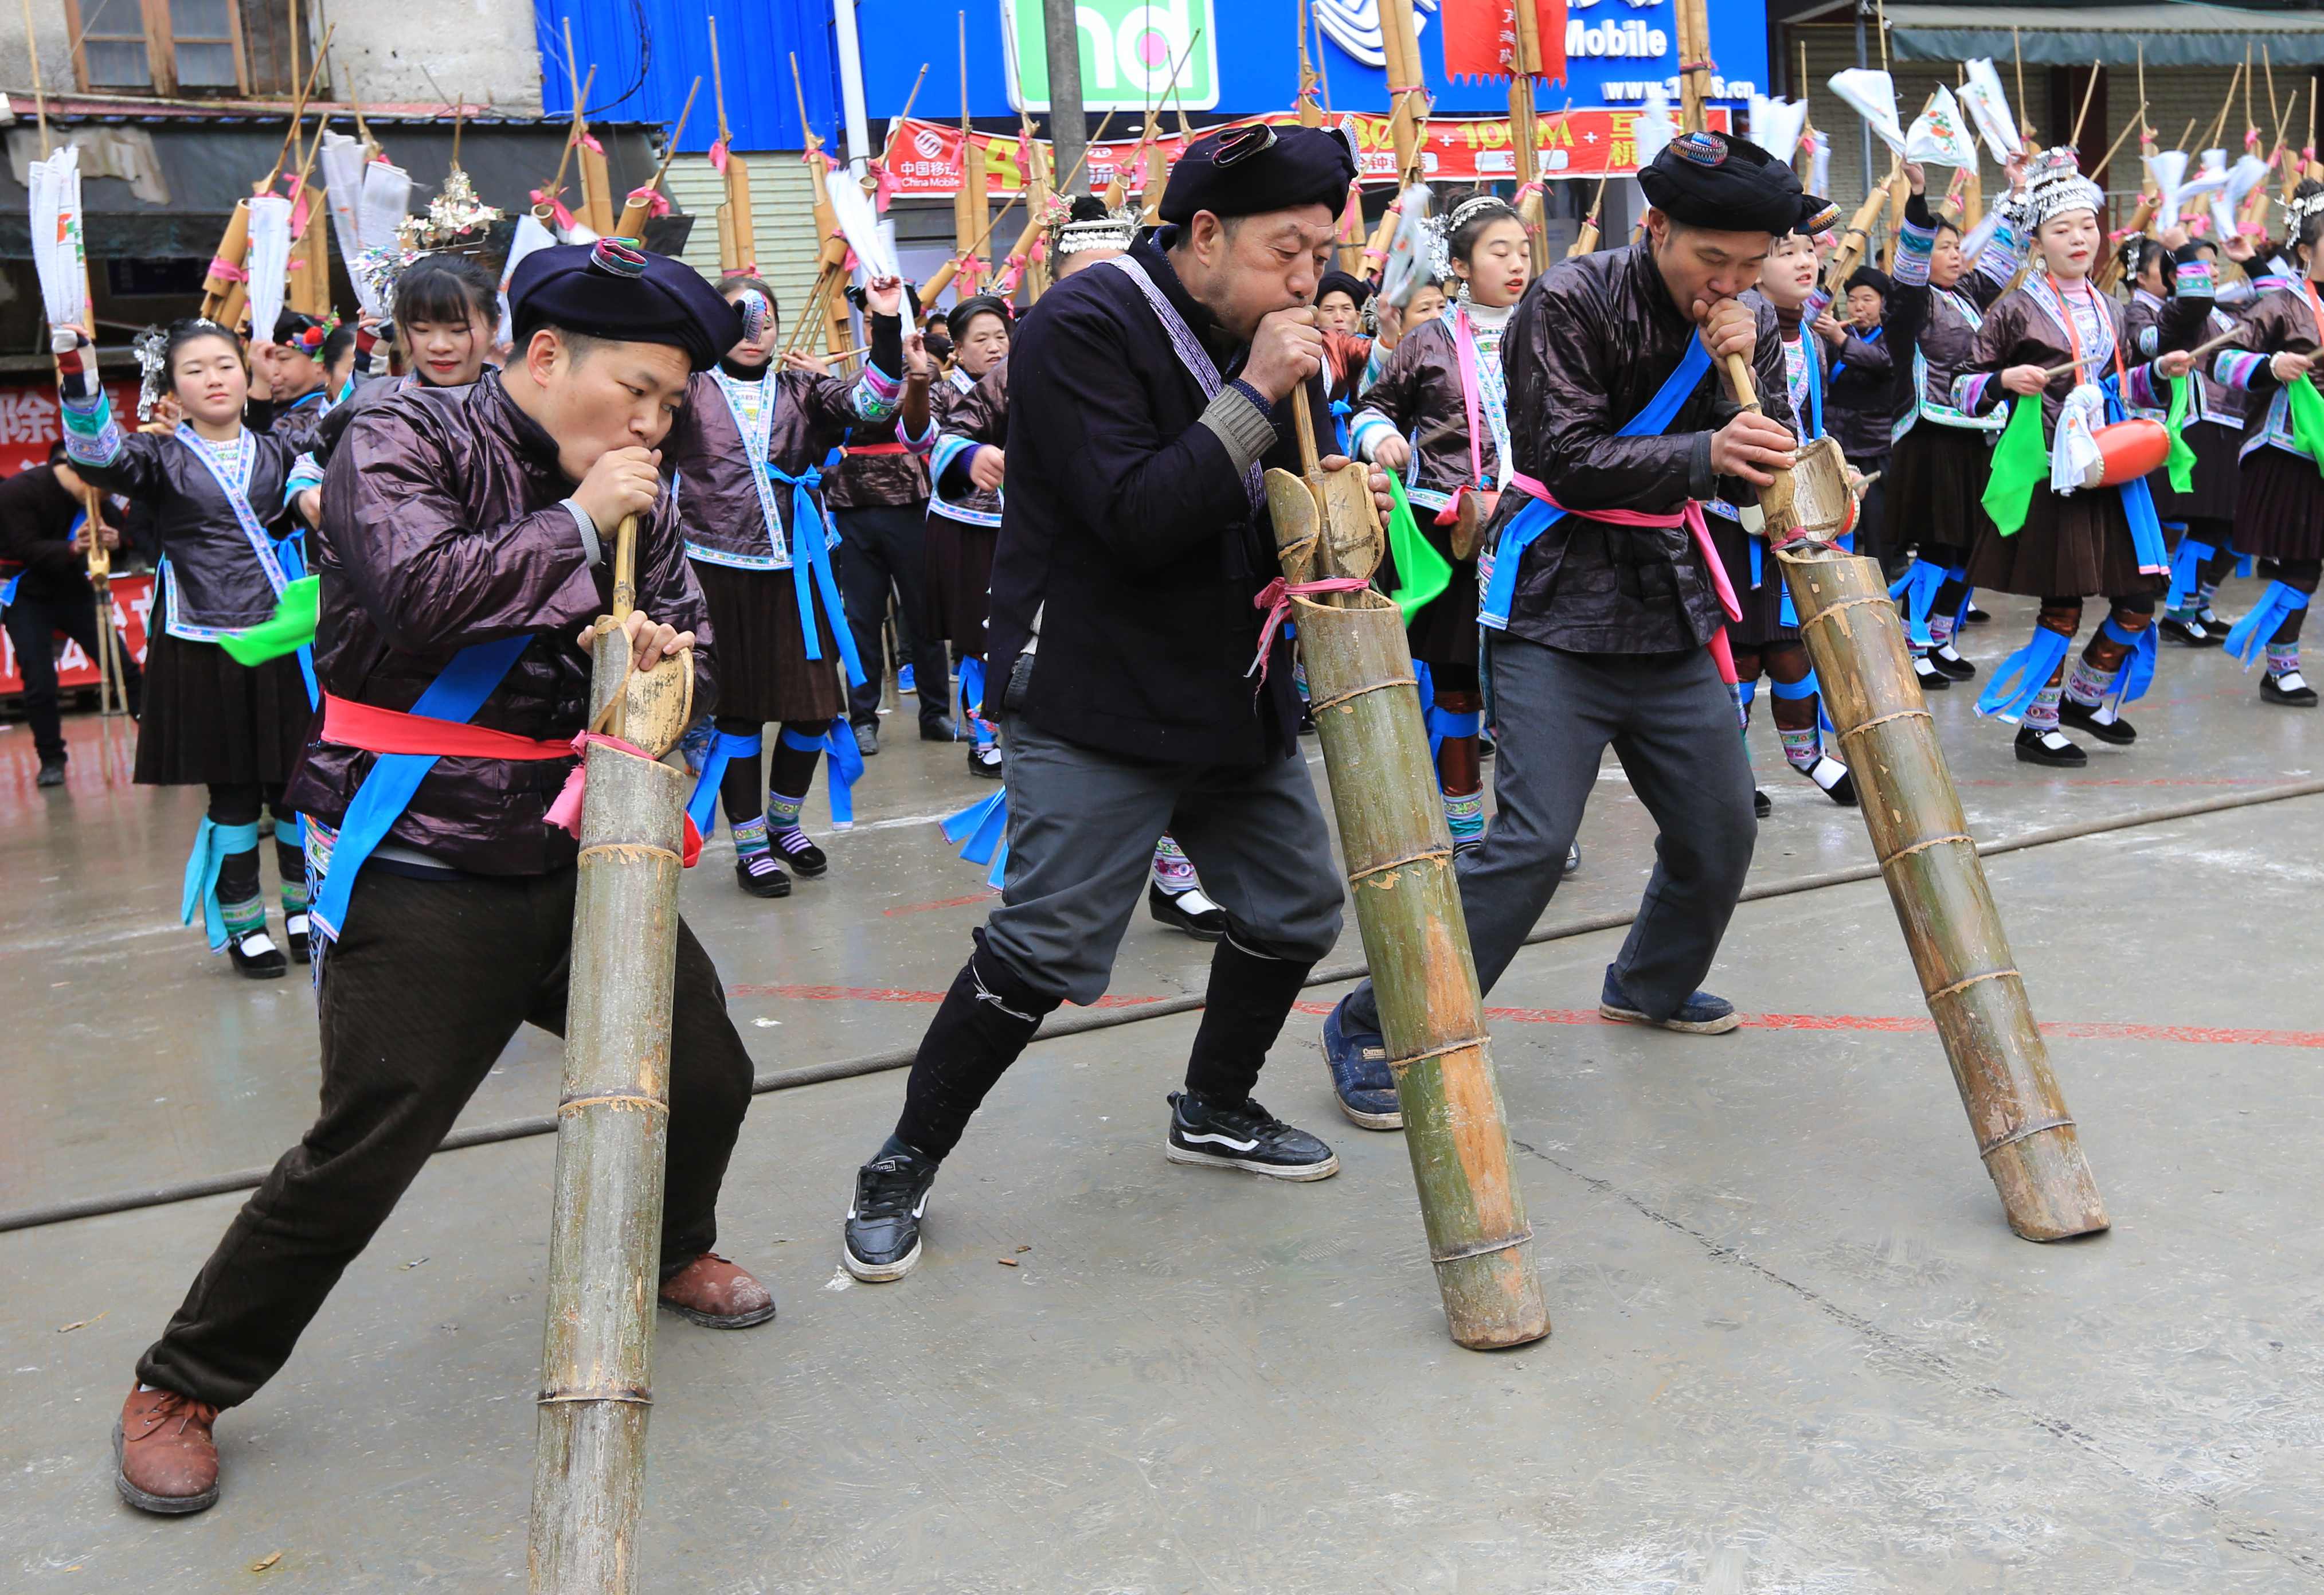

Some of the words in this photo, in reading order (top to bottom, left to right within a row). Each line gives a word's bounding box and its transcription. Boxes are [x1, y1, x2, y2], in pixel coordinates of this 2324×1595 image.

[1456, 119, 1575, 149] 10M
[901, 177, 929, 187] China
[930, 177, 960, 187] Mobile
